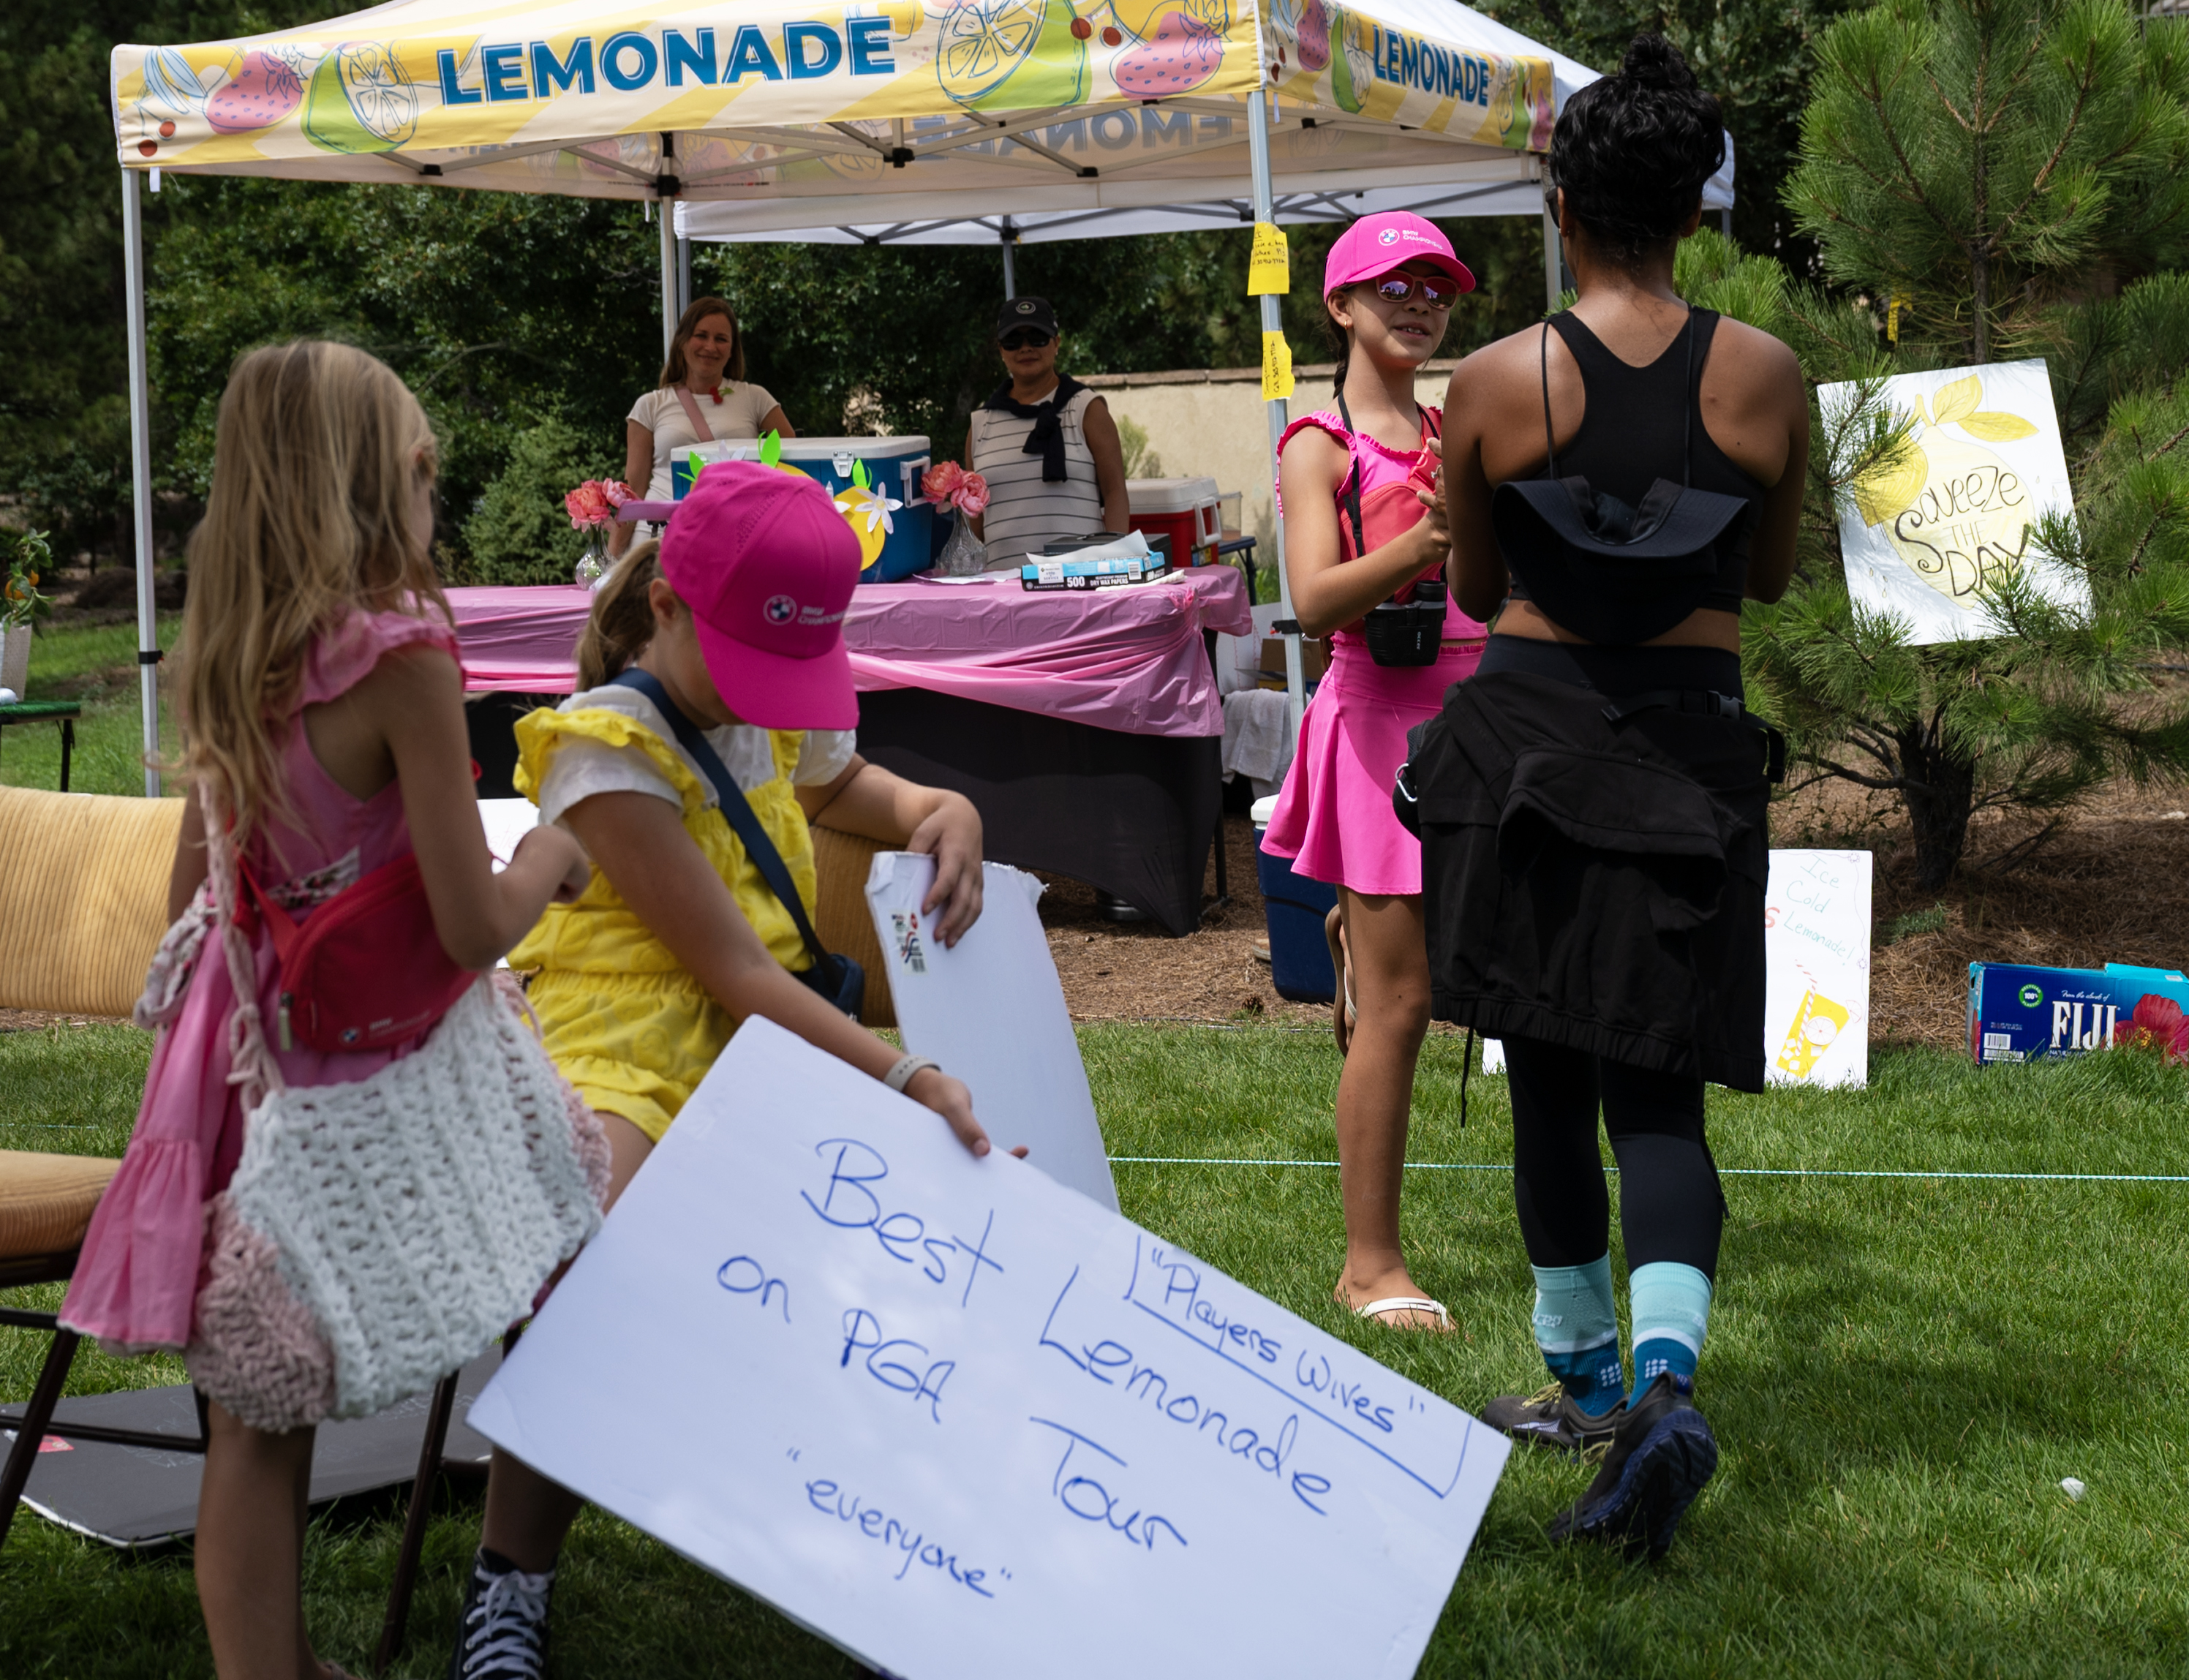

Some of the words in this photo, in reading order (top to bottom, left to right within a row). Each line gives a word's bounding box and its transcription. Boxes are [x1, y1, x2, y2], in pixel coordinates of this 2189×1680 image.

[437, 15, 900, 109] LEMONADE
[1373, 24, 1489, 108] LEMONADE
[1943, 519, 1988, 548] THE
[1067, 576, 1085, 587] 500
[1800, 854, 1839, 889] Ice
[1787, 880, 1831, 913] Cold
[1784, 911, 1855, 966] Lemonade!
[2062, 990, 2075, 998] From
[2076, 990, 2084, 998] the
[2103, 993, 2111, 1002] of
[2049, 1001, 2118, 1050] FIJI
[800, 1138, 1003, 1308] Best
[1039, 1263, 1332, 1516] Lemonade
[716, 1254, 791, 1325] on
[840, 1308, 956, 1425] PGA
[1028, 1416, 1188, 1551] Tour
